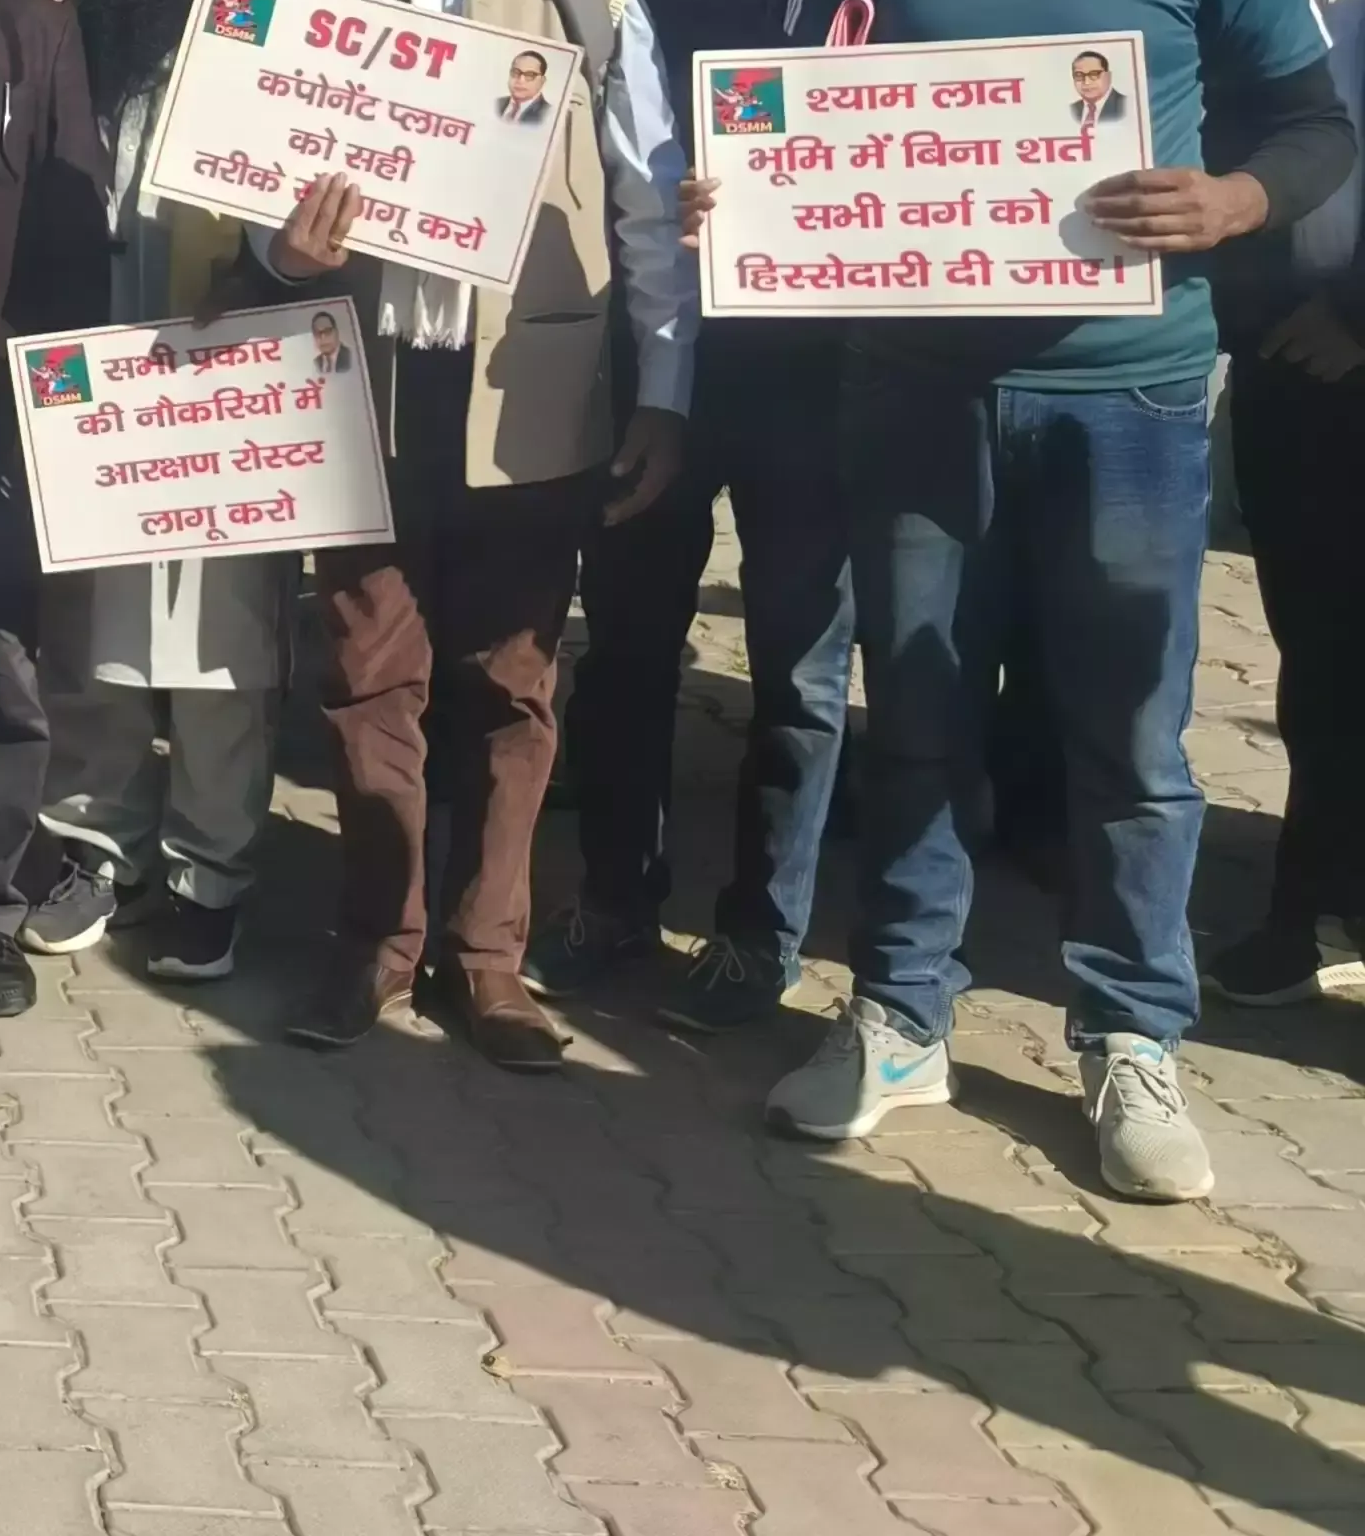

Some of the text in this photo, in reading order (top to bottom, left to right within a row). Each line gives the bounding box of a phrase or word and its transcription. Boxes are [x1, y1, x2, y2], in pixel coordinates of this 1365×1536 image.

[214, 24, 257, 43] DSMM
[304, 9, 458, 80] SC/ST
[257, 68, 476, 146] कंपोनेंट प्लान
[804, 76, 1025, 114] श्याम लात
[725, 120, 774, 134] DSMM
[288, 127, 417, 183] को सही
[748, 125, 1096, 187] भूमि में बिना शर्त
[193, 150, 287, 194] तरीके
[417, 210, 488, 252] करो
[792, 187, 1054, 232] सभी वर्ग को
[735, 249, 934, 293] हिस्सेदारी
[942, 249, 993, 288] दी
[101, 337, 283, 382] सभी प्रकार
[41, 392, 83, 406] DSMM
[74, 378, 327, 436] की नौकरियों में
[94, 439, 326, 488] आरक्षण रोस्टर
[137, 489, 296, 542] लागू करो
